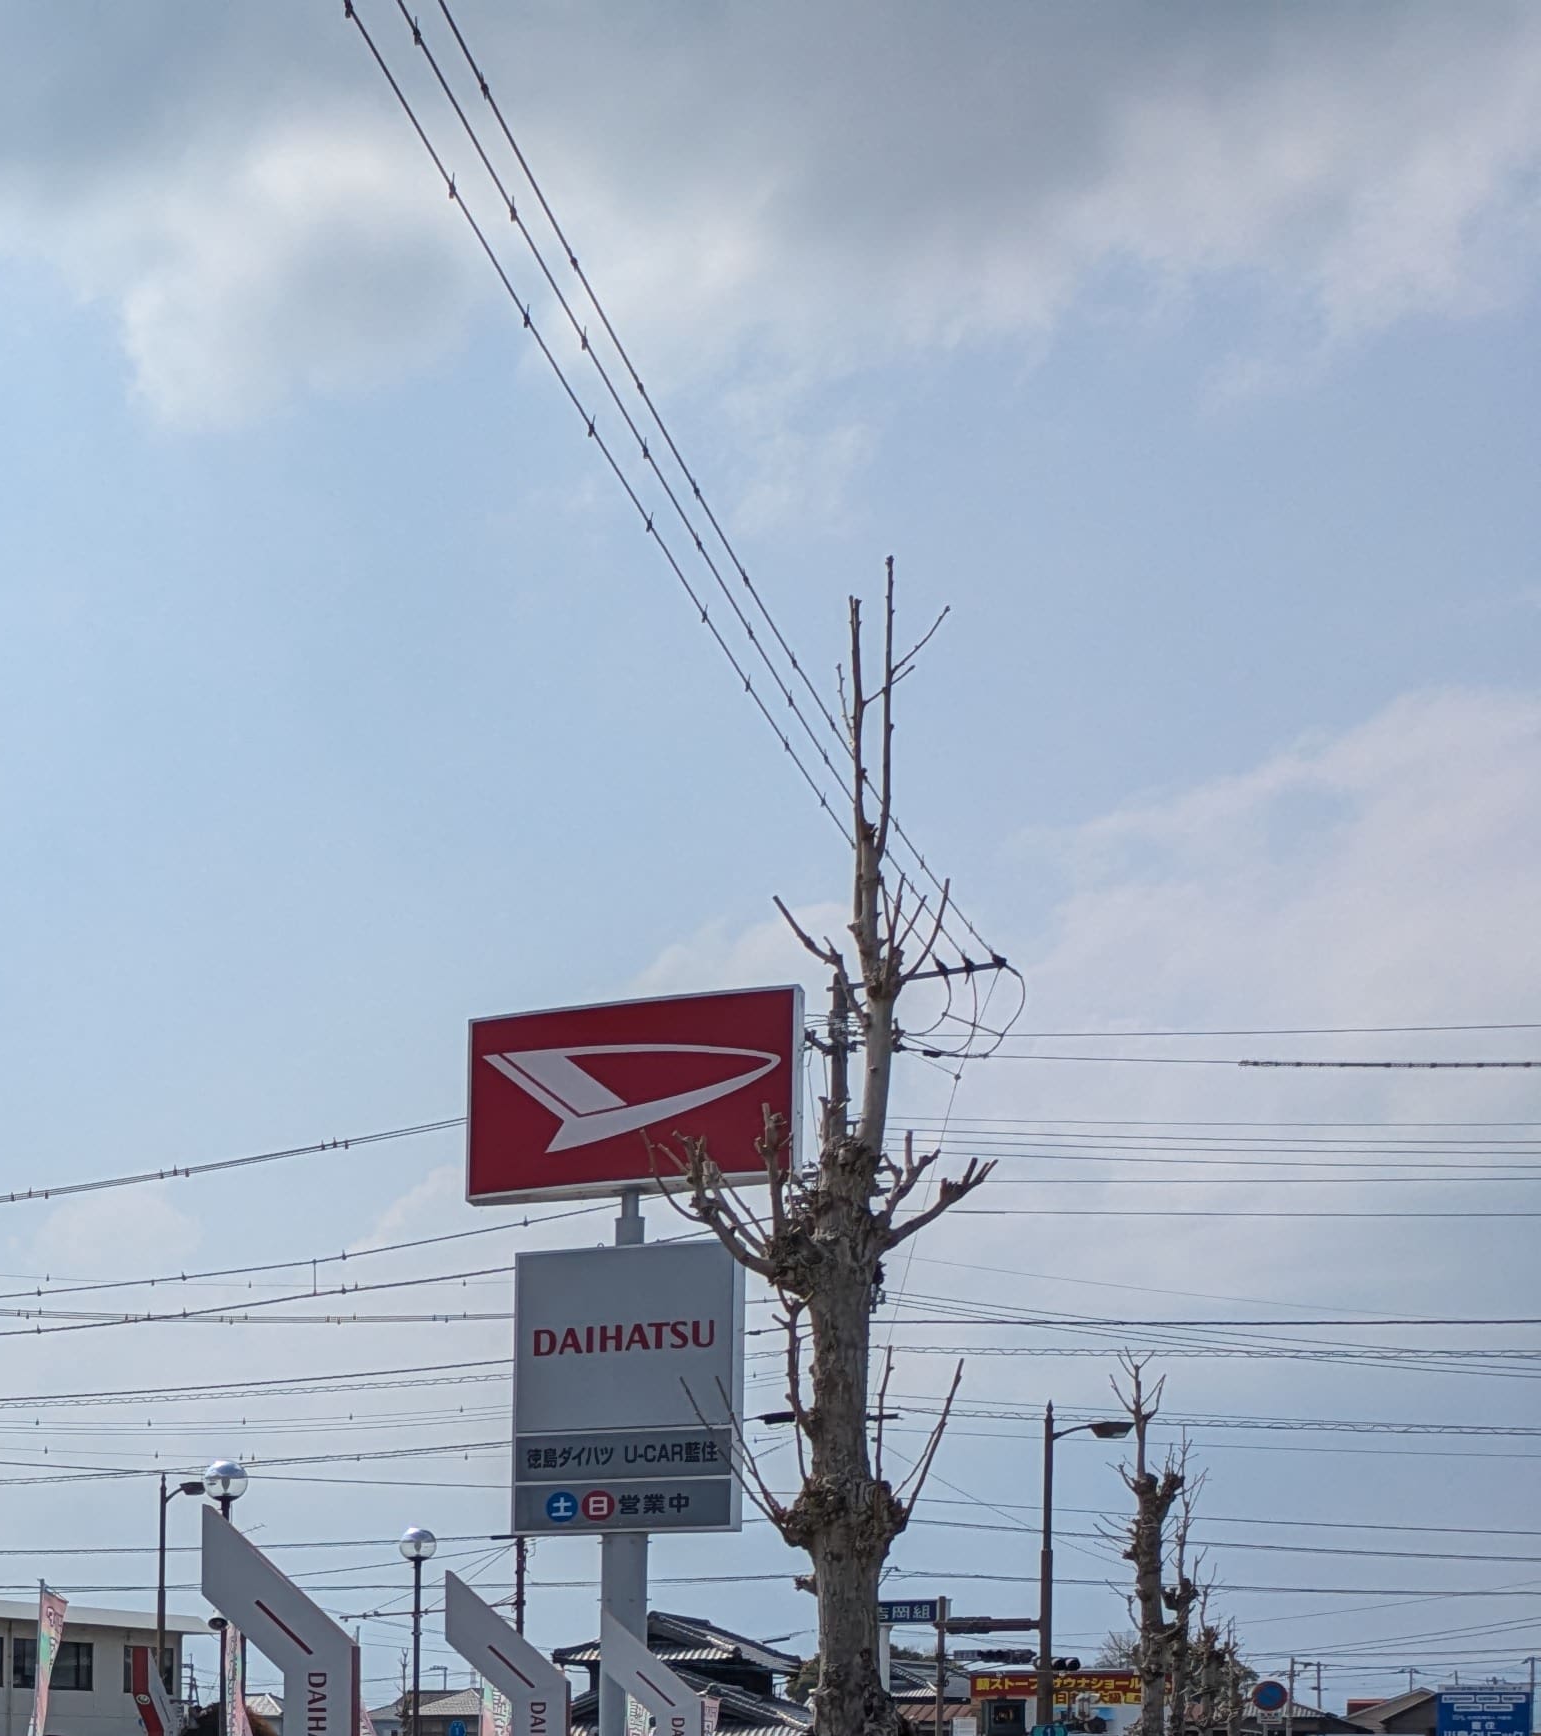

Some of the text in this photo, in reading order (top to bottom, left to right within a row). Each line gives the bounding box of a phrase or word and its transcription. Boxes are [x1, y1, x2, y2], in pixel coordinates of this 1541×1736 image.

[533, 1320, 714, 1356] DAIHATSU
[527, 1446, 614, 1469] 徳島ダイハツ
